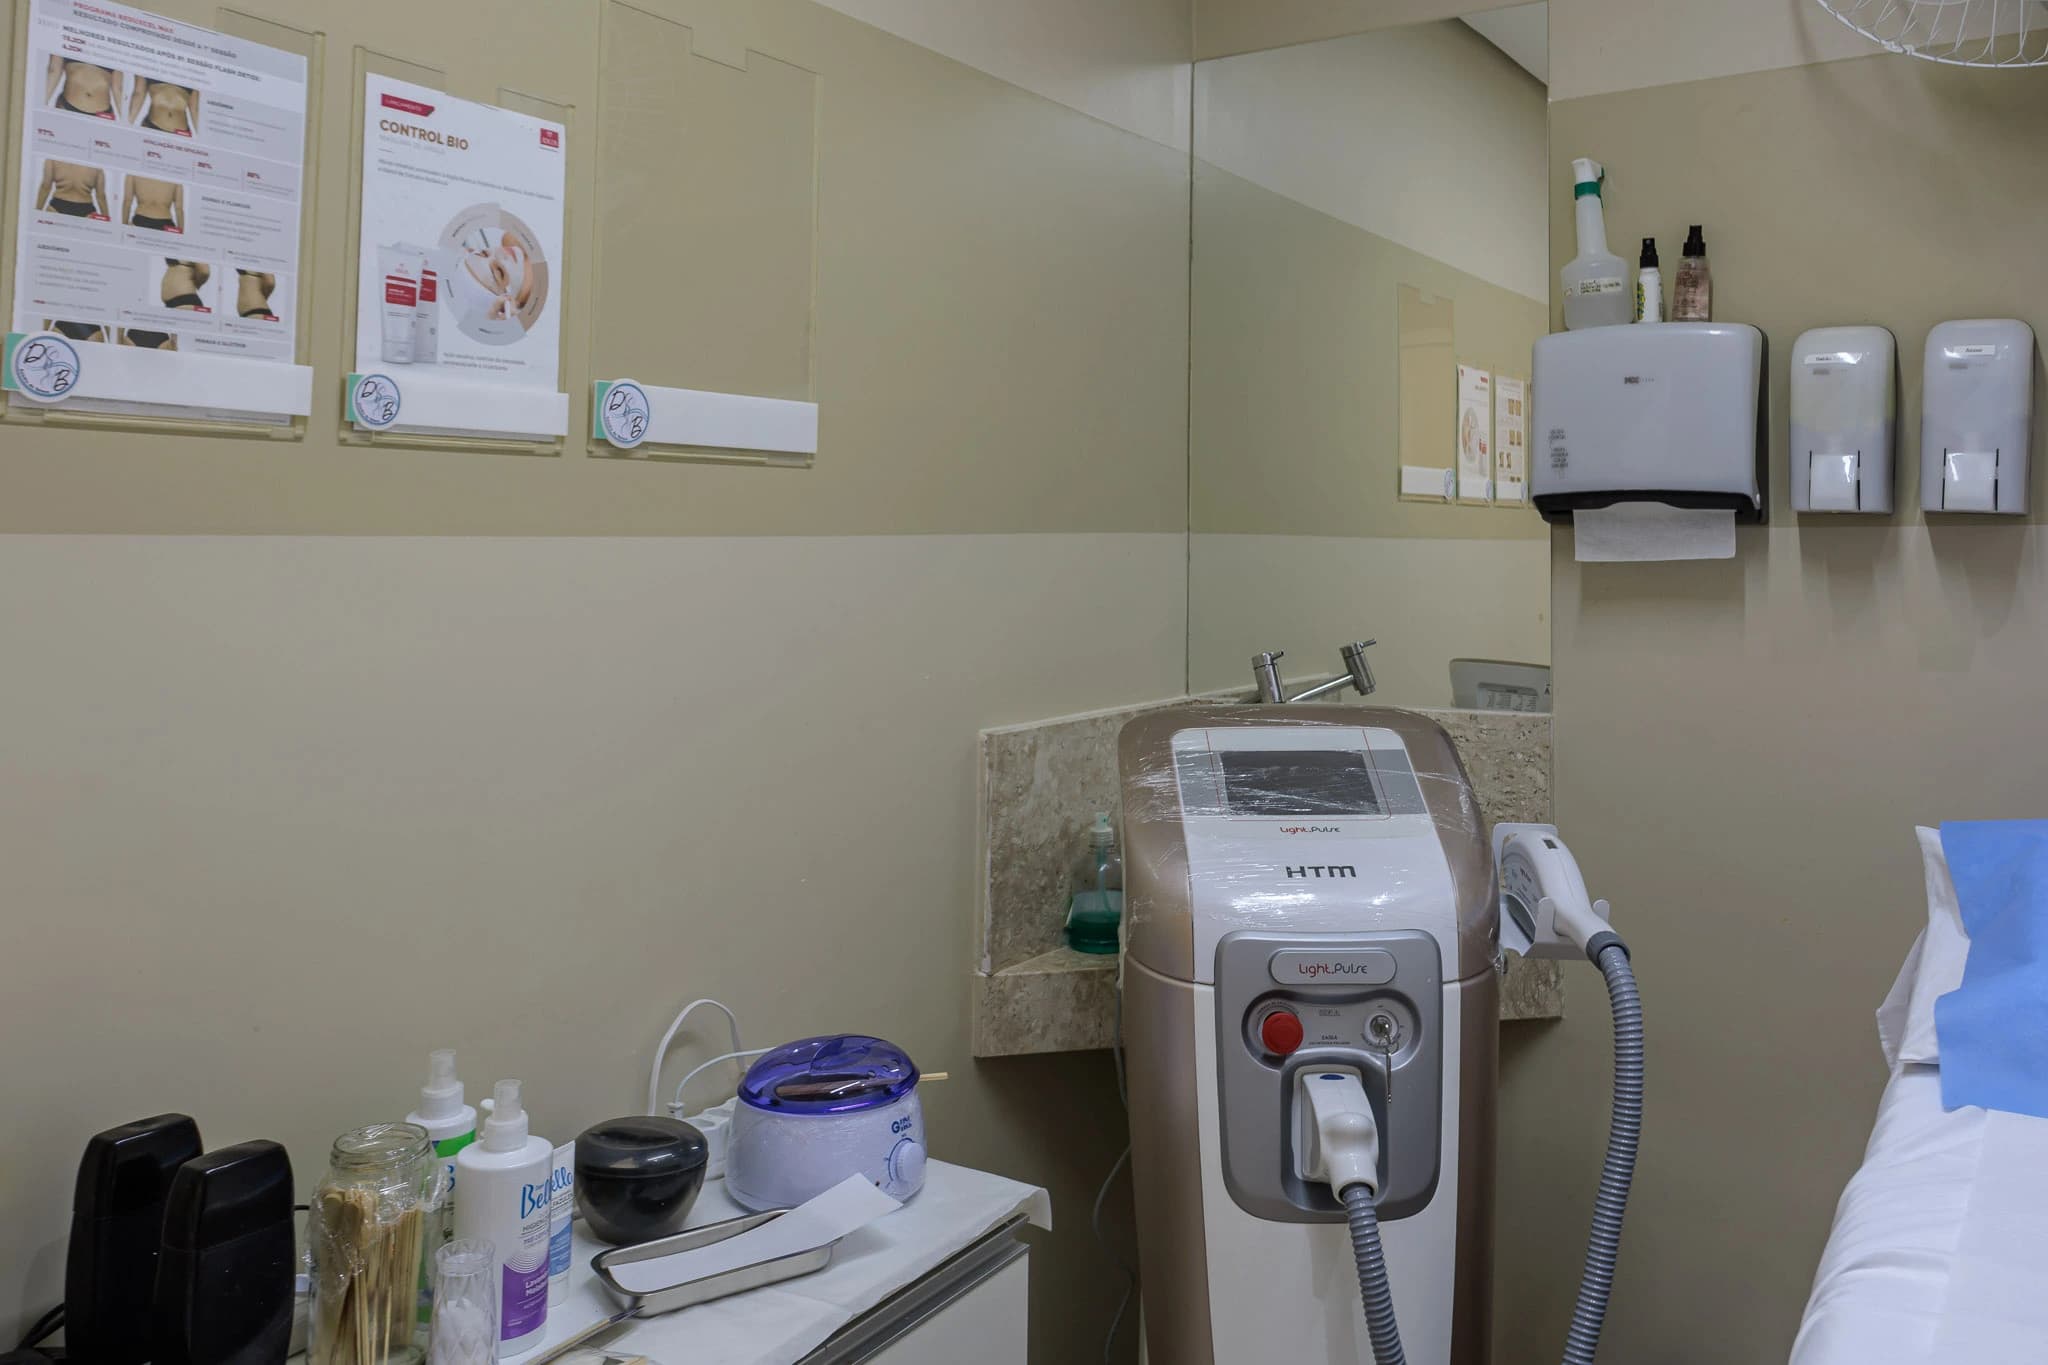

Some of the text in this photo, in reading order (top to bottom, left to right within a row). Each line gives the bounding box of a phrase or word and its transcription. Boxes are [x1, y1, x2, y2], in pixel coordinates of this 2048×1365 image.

[380, 119, 444, 145] CONTROL
[447, 135, 469, 150] BIO
[1286, 865, 1356, 878] HTM
